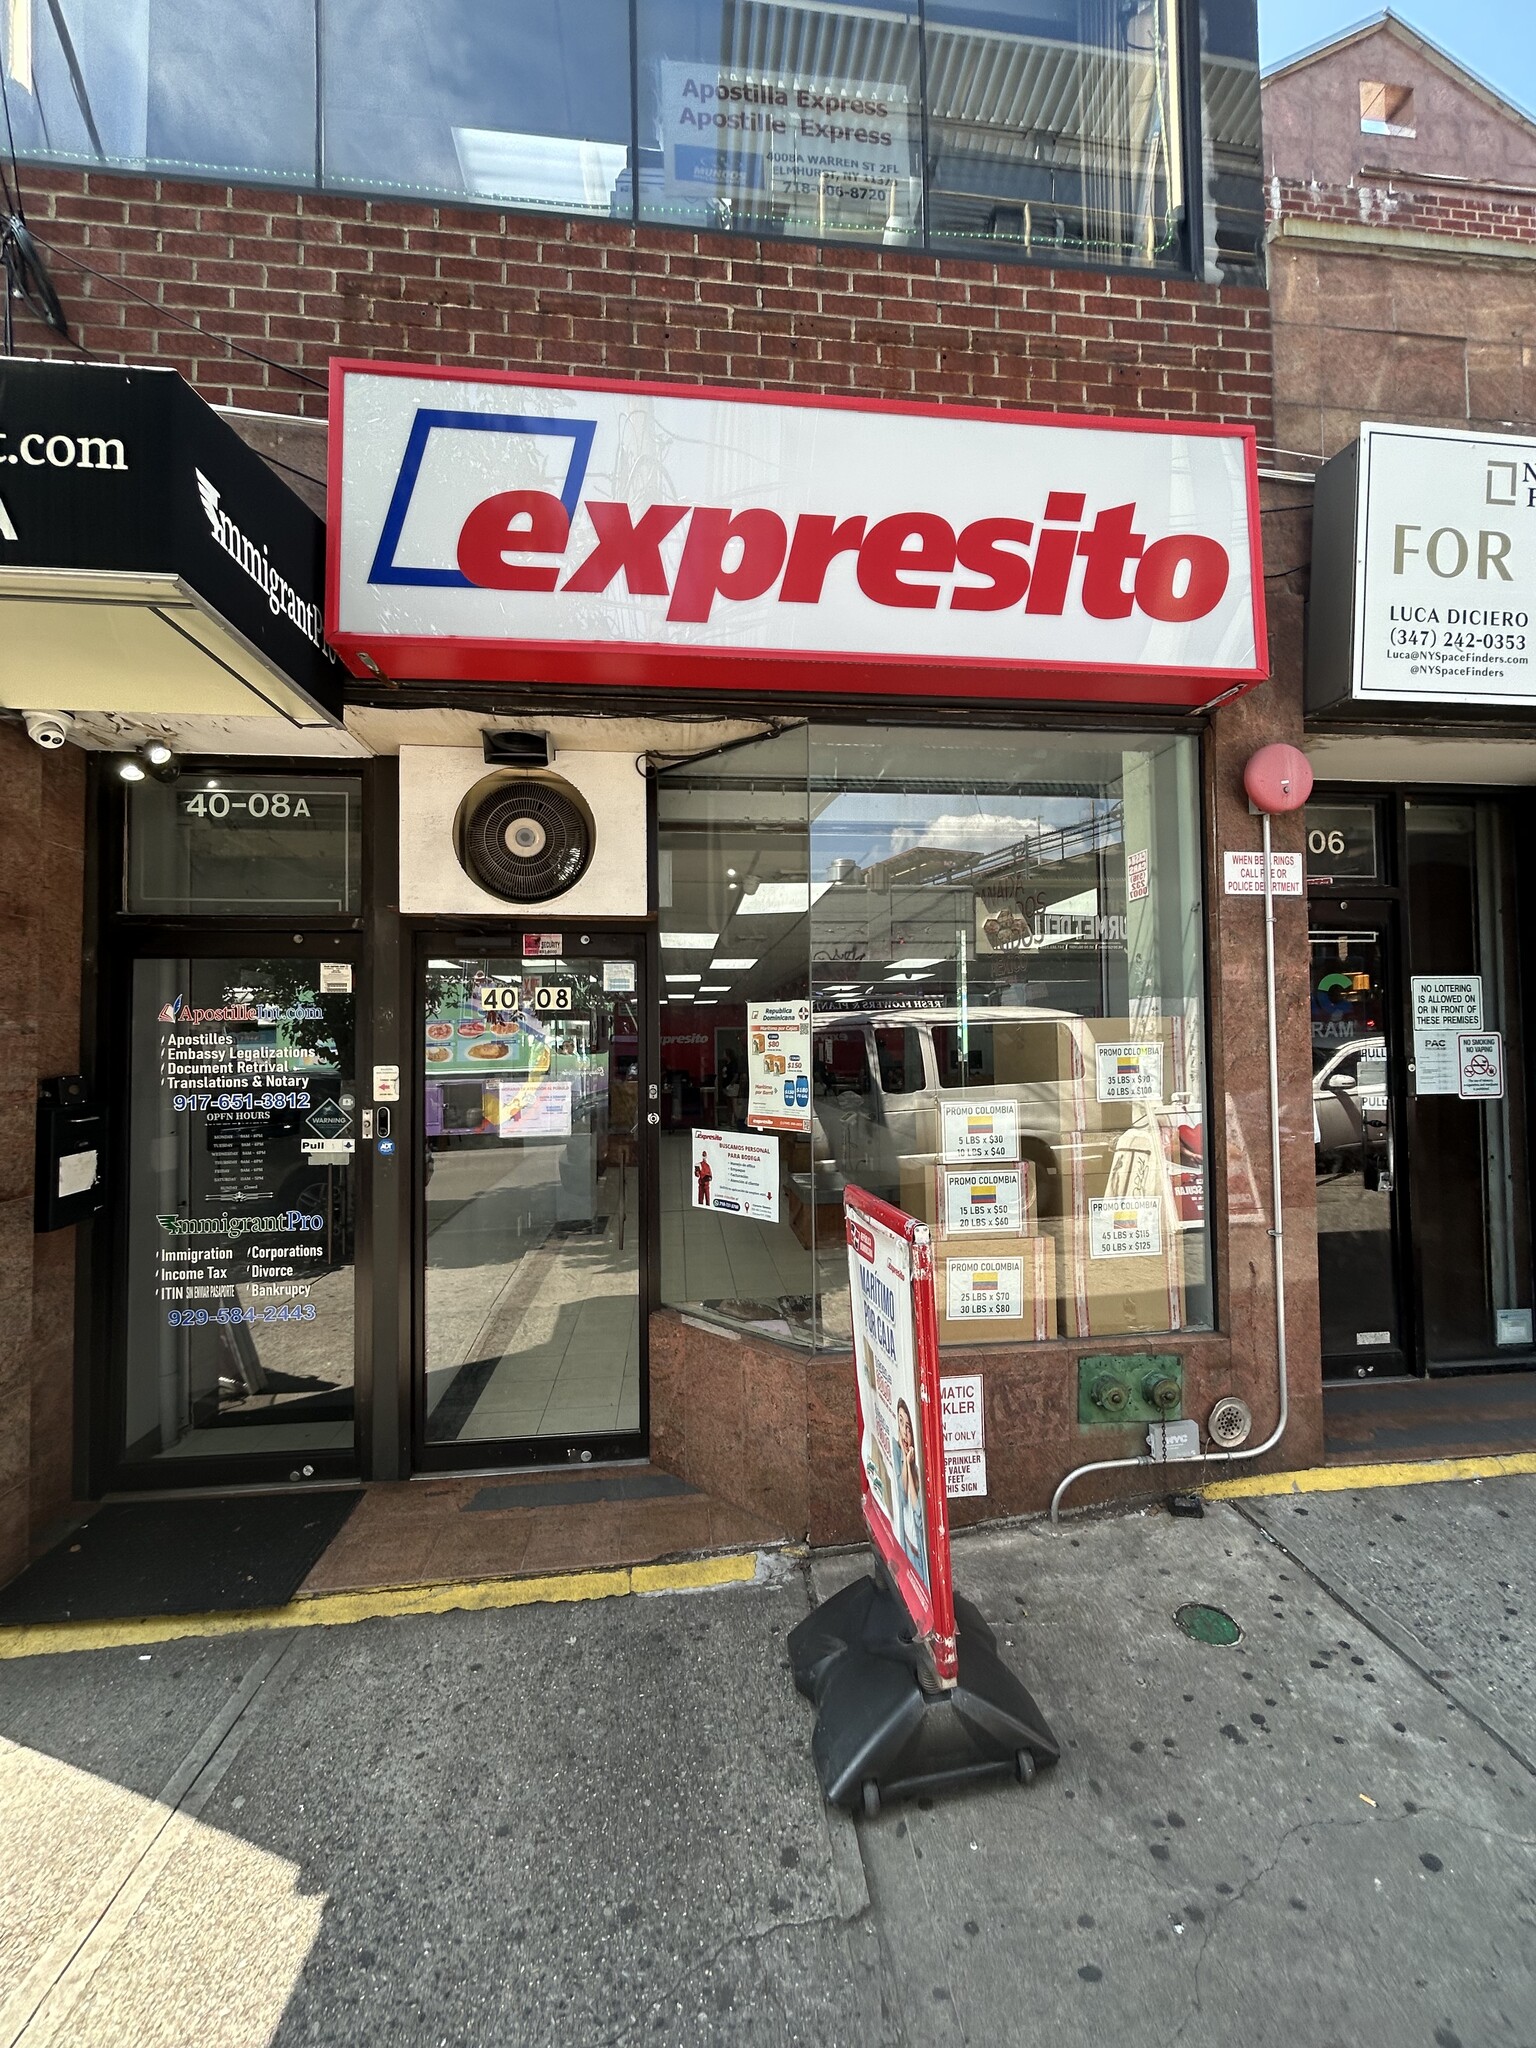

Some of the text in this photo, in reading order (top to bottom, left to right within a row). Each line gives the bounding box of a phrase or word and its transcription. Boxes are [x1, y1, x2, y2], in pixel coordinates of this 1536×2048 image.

[682, 78, 888, 118] Apostilla Express
[680, 107, 892, 146] Apostille Express
[766, 151, 899, 175] 4008A WARREN ST 2FL
[843, 170, 860, 182] NY
[456, 489, 1230, 623] expresito
[1393, 523, 1515, 582] FOR
[1390, 605, 1529, 628] LUCA DICIERO
[1390, 627, 1526, 650] (347) 242-0353
[1386, 649, 1529, 665] Luca@NYSpaceFinders.com
[1410, 665, 1504, 678] @NYSpaceFinders
[186, 792, 311, 818] 40-08A
[1308, 830, 1345, 855] 06
[1232, 855, 1253, 865] WHEN
[1273, 856, 1295, 866] RINGS
[1240, 868, 1259, 878] CALL
[1276, 869, 1287, 878] OR
[1228, 881, 1254, 891] POLICE
[1420, 984, 1472, 993] NO LOITERING
[483, 988, 569, 1009] 40 08
[1418, 995, 1476, 1003] IS ALLOWED ON
[178, 1003, 323, 1026] ApostilleInt.com
[1417, 1005, 1477, 1014] OR IN FRONT OF
[1417, 1016, 1479, 1025] THESE PREMISES
[167, 1033, 233, 1046] Apostilles
[1425, 1039, 1446, 1048] PAC
[1471, 1038, 1496, 1047] SMOKING
[167, 1047, 316, 1061] Embassy Legalizations
[1100, 1047, 1160, 1057] PROMO COLOMBIA
[1475, 1046, 1494, 1054] VAPING
[167, 1060, 289, 1075] Document Retrival
[167, 1074, 310, 1089] Translations & Notary
[1107, 1076, 1116, 1084] 35
[1107, 1088, 1116, 1096] 40
[1116, 1087, 1130, 1096] LBS
[173, 1092, 311, 1112] 917-651-3812
[236, 1111, 271, 1121] HOURS
[946, 1106, 1014, 1116] PROMO COLOMBIA
[312, 1117, 347, 1125] WARNING
[958, 1135, 1004, 1144] 5 LBS $30
[302, 1141, 325, 1150] Pull
[719, 1142, 771, 1154] BUSCAMOS PERSONAL
[967, 1147, 982, 1156] LBS
[990, 1146, 1006, 1156] $40
[741, 1154, 761, 1162] BODEGA
[949, 1175, 1017, 1186] PROMO COLOMBIA
[960, 1204, 1008, 1215] 15 LBS $50
[1092, 1201, 1158, 1212] PROMO COLOMBIA
[959, 1216, 1009, 1227] 20 LBS $60
[1101, 1231, 1111, 1240] 45
[1112, 1230, 1127, 1239] LBS
[1101, 1241, 1151, 1252] 50 LBS $125
[161, 1244, 323, 1263] Immigration Corporations
[161, 1264, 293, 1281] Income Tax Divorce
[951, 1262, 1020, 1272] PROMO COLOMBIA
[161, 1286, 183, 1300] ITIN
[251, 1283, 312, 1298] Bankrupcy
[960, 1291, 1010, 1301] 25 LBS $70
[960, 1304, 1010, 1314] 30 LBS $80
[168, 1303, 316, 1327] 929-584-2443
[954, 1430, 976, 1441] ONLY
[1165, 1434, 1188, 1444] NYC
[948, 1465, 971, 1475] VALVE
[948, 1475, 965, 1484] FEET
[960, 1483, 978, 1492] SIGN
